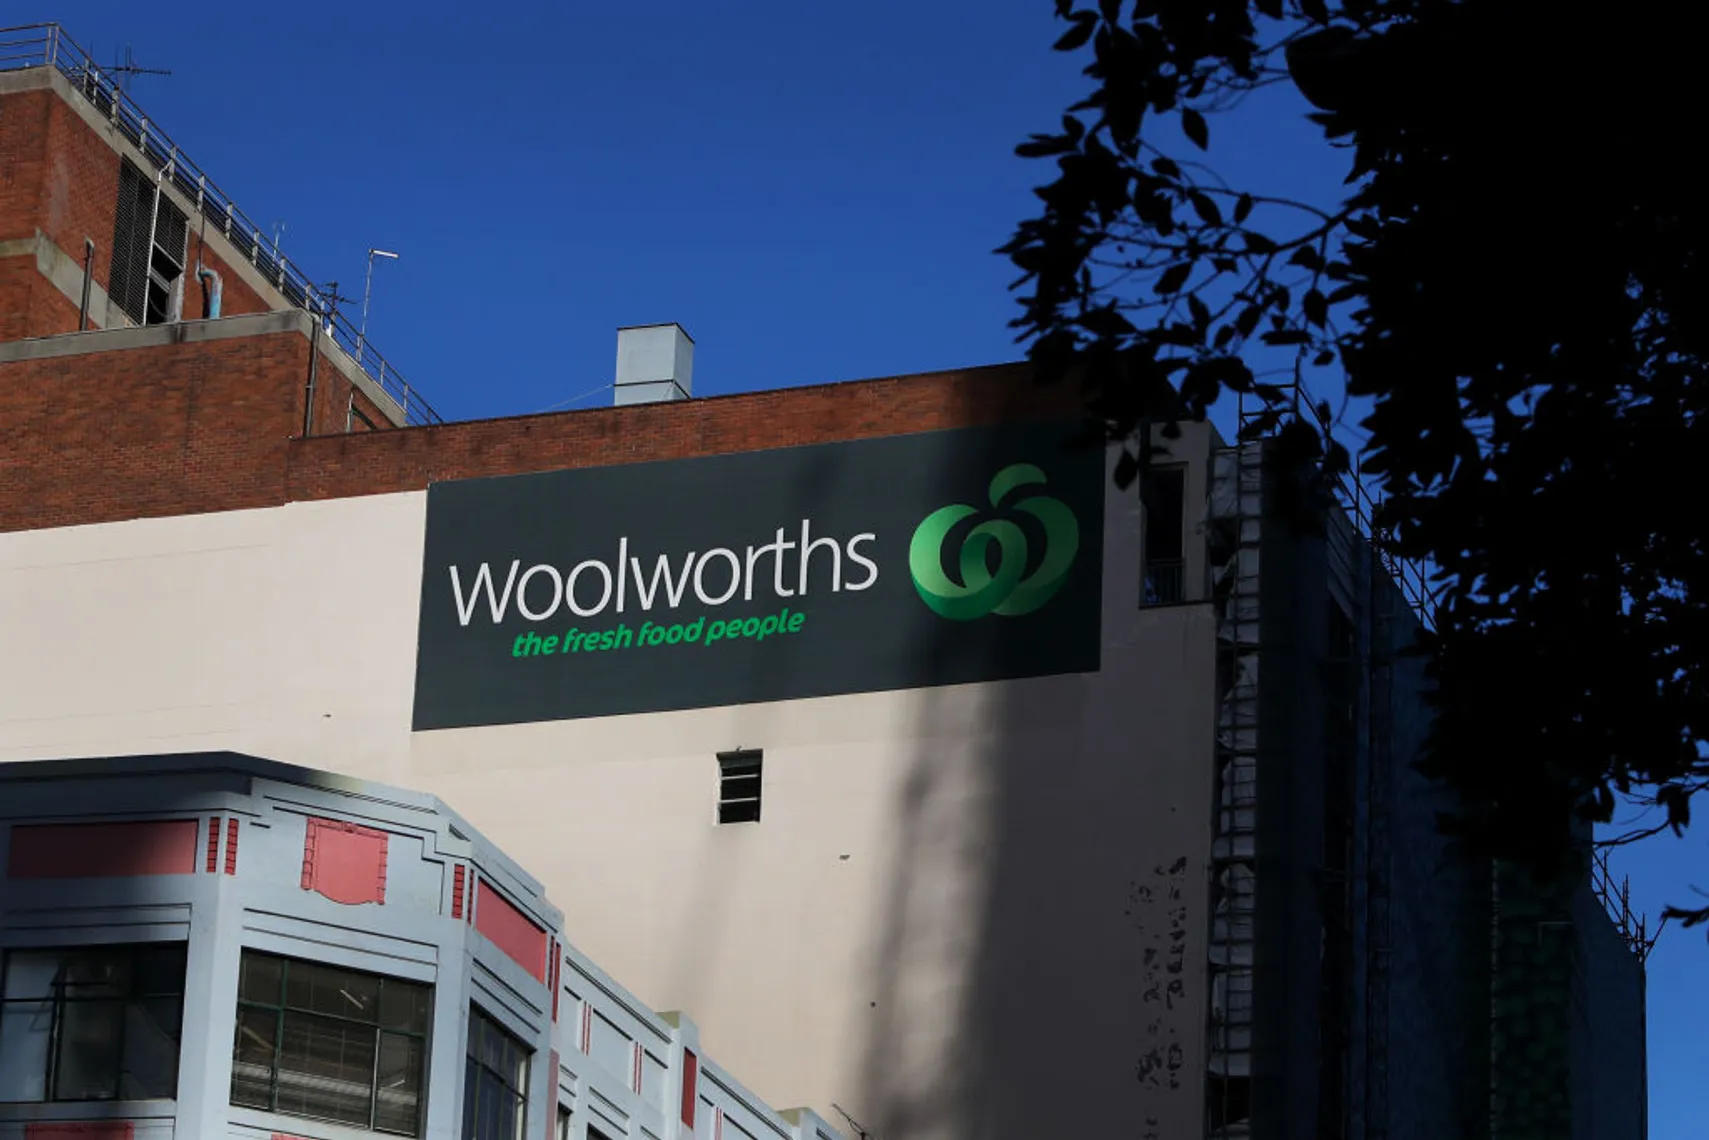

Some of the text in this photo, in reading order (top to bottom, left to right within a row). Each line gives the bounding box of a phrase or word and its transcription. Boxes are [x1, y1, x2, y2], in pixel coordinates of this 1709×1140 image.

[449, 519, 879, 626] Woolworths
[512, 607, 806, 658] the fresh food people
